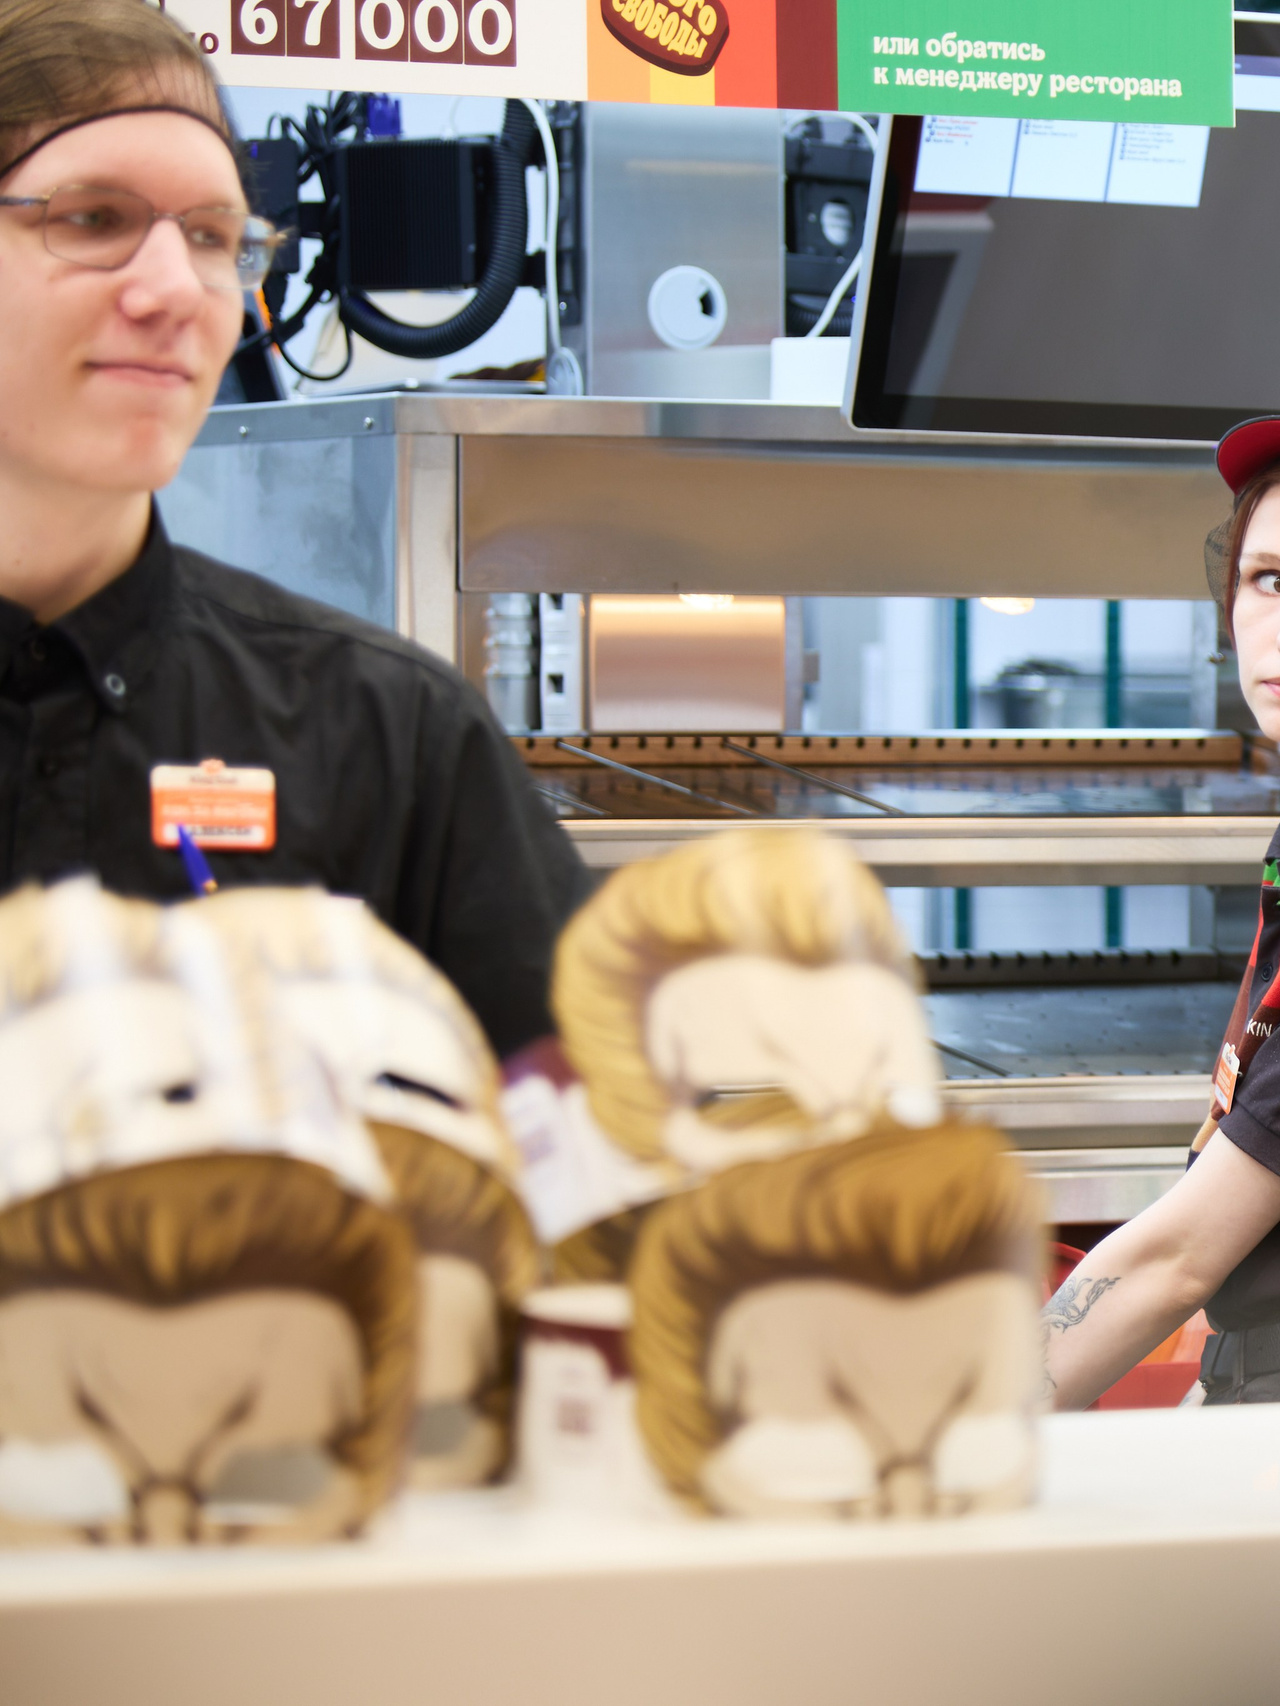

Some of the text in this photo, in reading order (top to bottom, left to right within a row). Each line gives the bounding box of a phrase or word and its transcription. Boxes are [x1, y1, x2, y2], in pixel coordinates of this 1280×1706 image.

[240, 0, 331, 46] 67
[360, 0, 513, 56] 000
[873, 31, 1046, 63] или обратись
[873, 66, 1183, 101] к менеджеру ресторана
[1246, 1018, 1273, 1038] KIN
